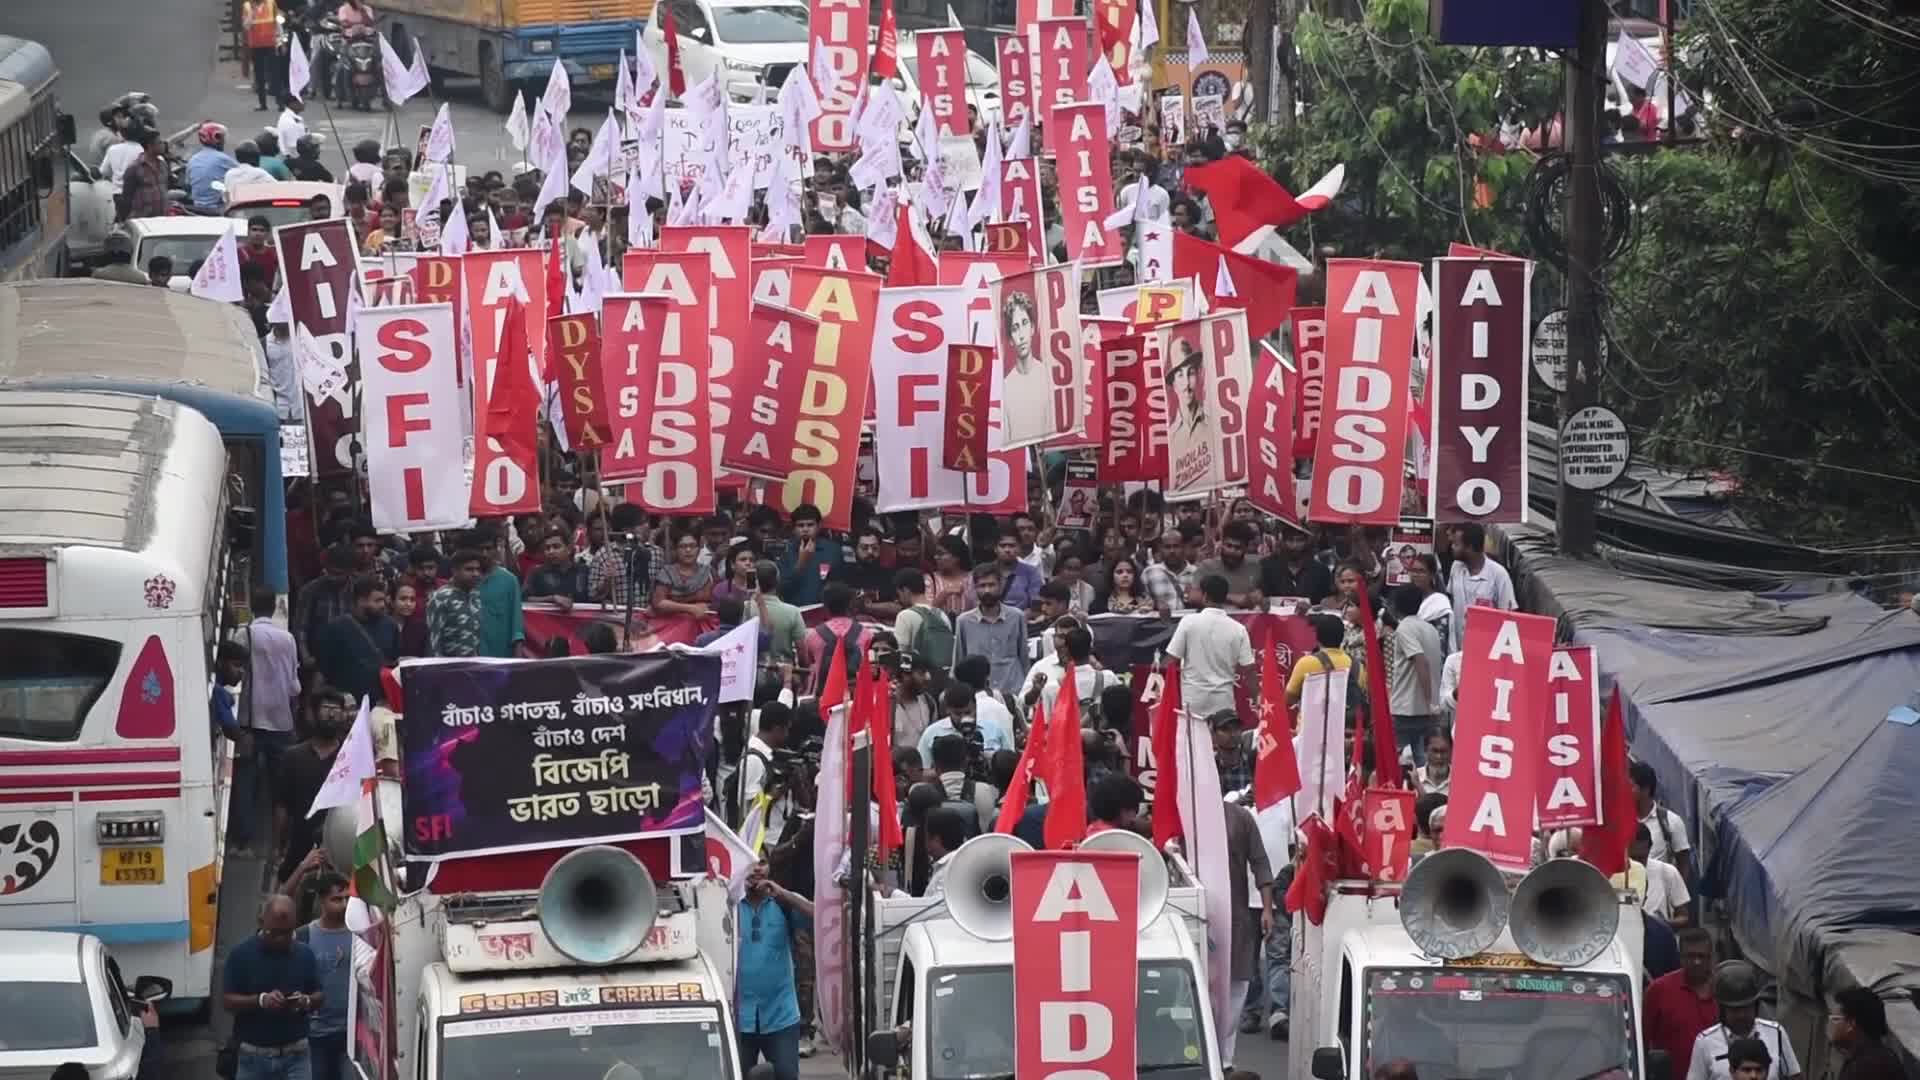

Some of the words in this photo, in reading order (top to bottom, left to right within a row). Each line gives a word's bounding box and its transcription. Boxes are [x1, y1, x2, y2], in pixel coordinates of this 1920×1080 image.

[817, 0, 861, 147] IDSO
[1003, 38, 1029, 119] AISA
[1053, 27, 1076, 105] AIS
[1070, 113, 1105, 248] AISA
[376, 318, 432, 521] SFI
[560, 320, 604, 447] DYSA
[614, 301, 645, 460] AISA
[642, 264, 699, 509] AIDSO
[743, 320, 794, 460] AISA
[782, 276, 859, 526] AIDSO
[892, 300, 944, 498] SFI
[953, 349, 984, 469] DYSA
[1047, 270, 1075, 434] PSU
[1107, 350, 1137, 466] PDSF
[1212, 319, 1248, 481] PSU
[1327, 270, 1401, 514] AIDSO
[1456, 269, 1503, 516] AIDYO
[1260, 364, 1285, 503] AISA
[1571, 420, 1613, 431] WALKING
[442, 701, 495, 728] বাঁচাও
[572, 690, 624, 717] বাঁচাও
[629, 685, 709, 712] সংবিধান,
[532, 725, 585, 748] বাঁচাও
[590, 724, 626, 745] দেশ
[532, 749, 630, 787] বিজেপি
[1469, 620, 1525, 838] AISA
[1546, 651, 1588, 811] AISA
[415, 815, 453, 841] SFI
[507, 791, 581, 823] ভারত
[588, 782, 661, 814] ছাড়ো
[462, 991, 558, 1013] GOODS
[600, 984, 704, 1003] CARRIER
[1031, 862, 1120, 1080] AID
